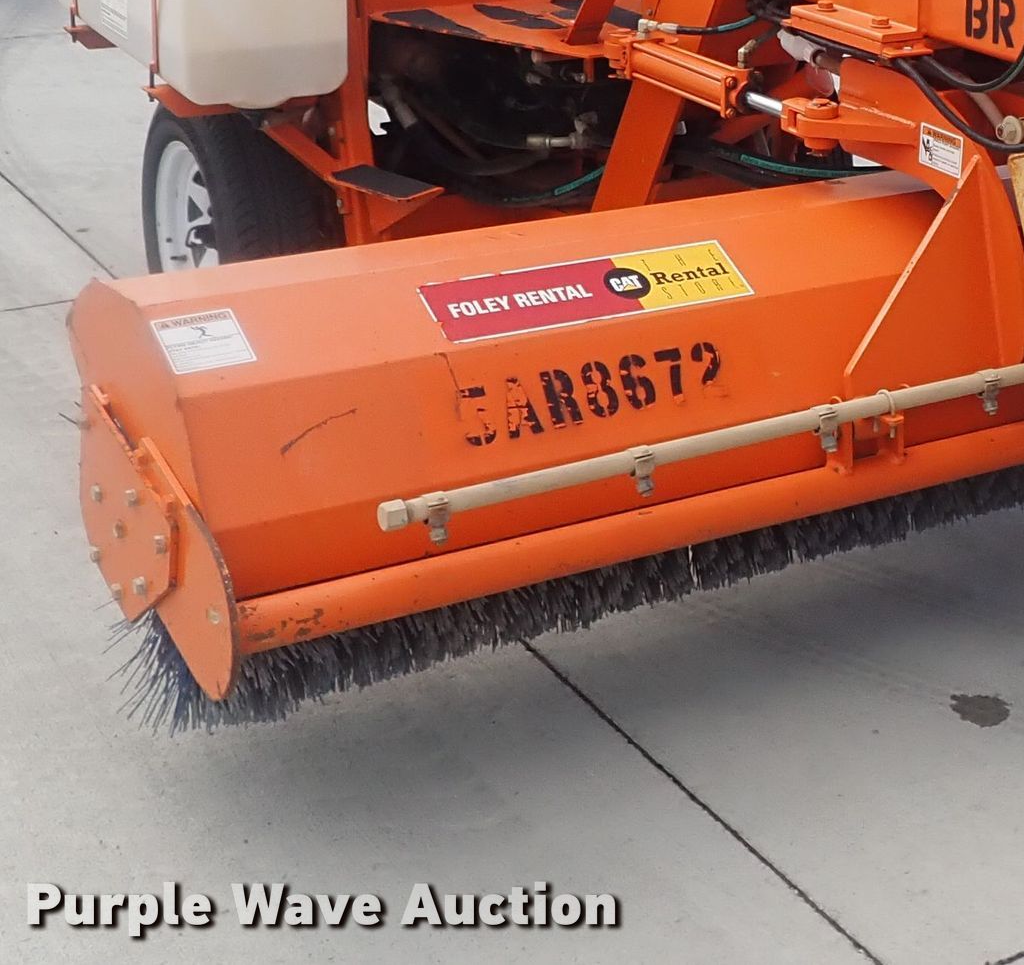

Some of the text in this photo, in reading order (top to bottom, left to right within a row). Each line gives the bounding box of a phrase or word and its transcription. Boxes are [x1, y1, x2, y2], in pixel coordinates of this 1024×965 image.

[609, 263, 729, 292] CAT Rental
[447, 284, 593, 318] FOLEY RENTAL
[174, 313, 228, 326] WARNING
[459, 342, 722, 446] 5AR8672
